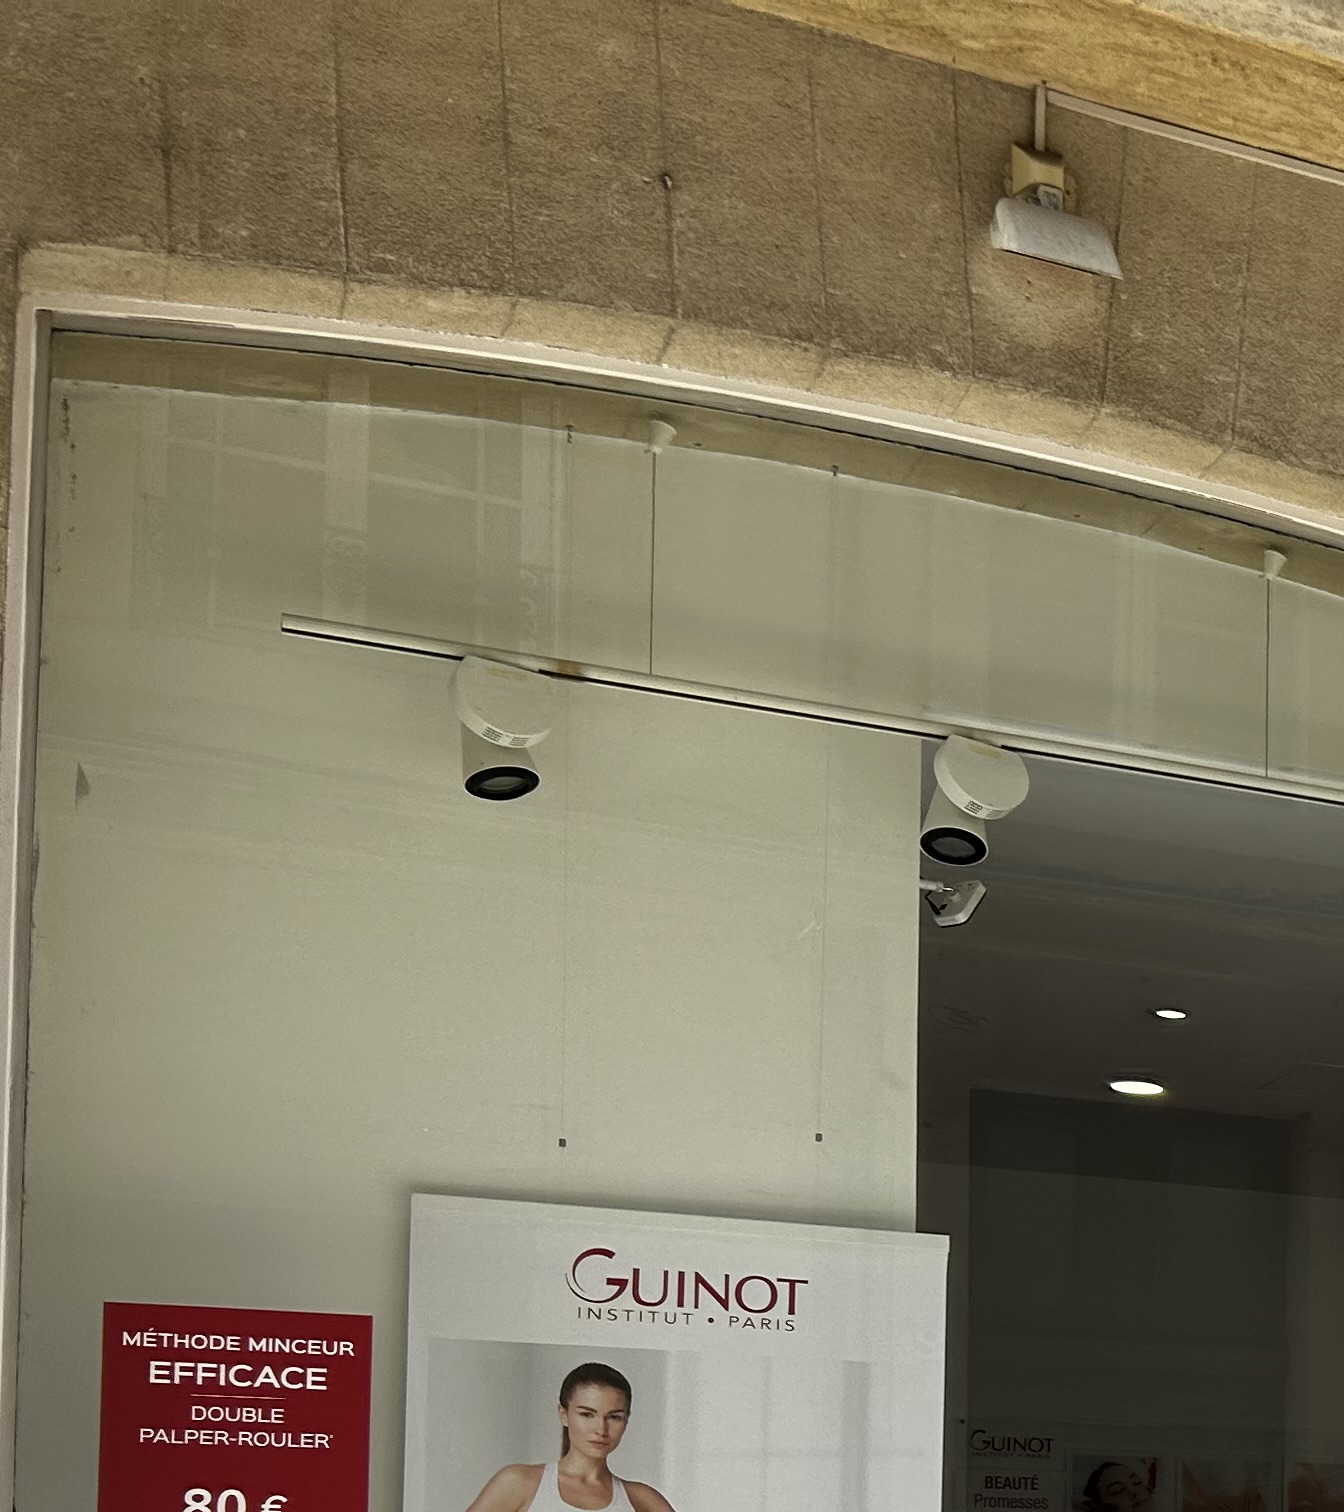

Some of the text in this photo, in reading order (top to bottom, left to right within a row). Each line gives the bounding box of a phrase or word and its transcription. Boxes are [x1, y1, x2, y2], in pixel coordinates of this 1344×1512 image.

[565, 1247, 809, 1315] GUINOT
[577, 1306, 796, 1332] INSTITUT PARIS
[122, 1328, 355, 1357] MÉTHODE MINCEUR
[149, 1361, 328, 1391] EFFICACE
[191, 1406, 285, 1424] DOUBLE
[969, 1429, 1055, 1453] GUINOT
[985, 1474, 1039, 1491] BEAUTÉ
[974, 1493, 1049, 1509] Promesses
